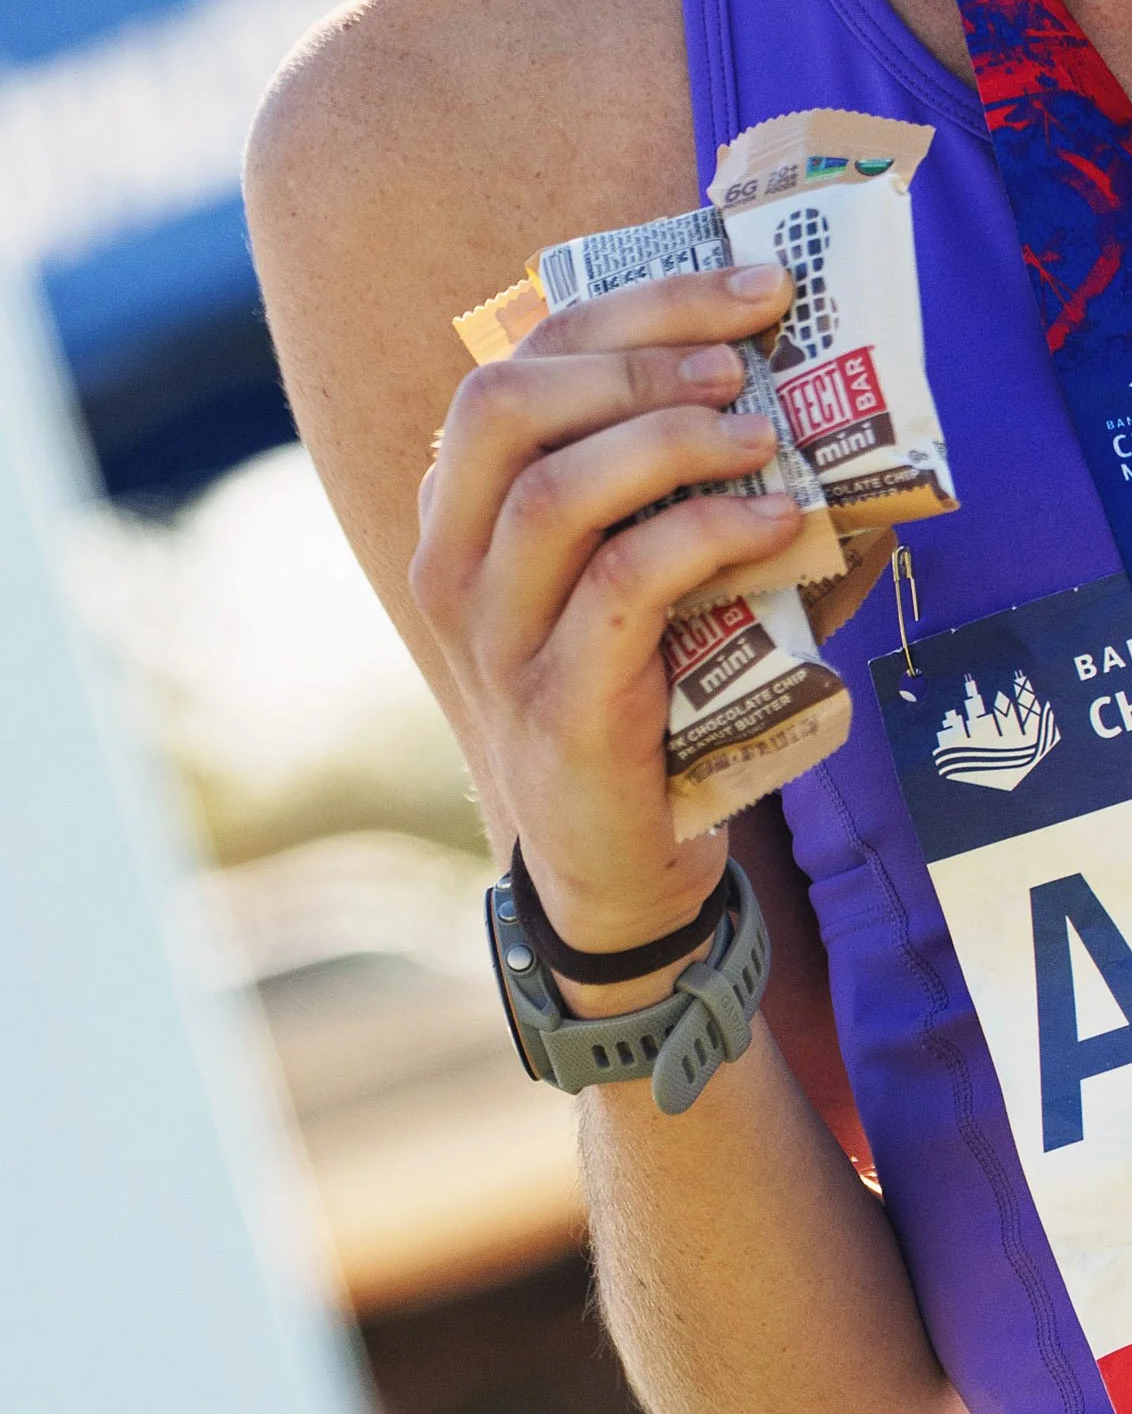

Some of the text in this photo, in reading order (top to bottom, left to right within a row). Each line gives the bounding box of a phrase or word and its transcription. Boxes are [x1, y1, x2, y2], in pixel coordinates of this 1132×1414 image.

[845, 355, 878, 412] BAR
[814, 420, 877, 467] mini
[699, 637, 757, 694] mini
[677, 727, 734, 761] PEANUT
[734, 693, 793, 732] BUTTER
[687, 685, 774, 742] CHOCOLATE
[773, 669, 808, 696] CHIP
